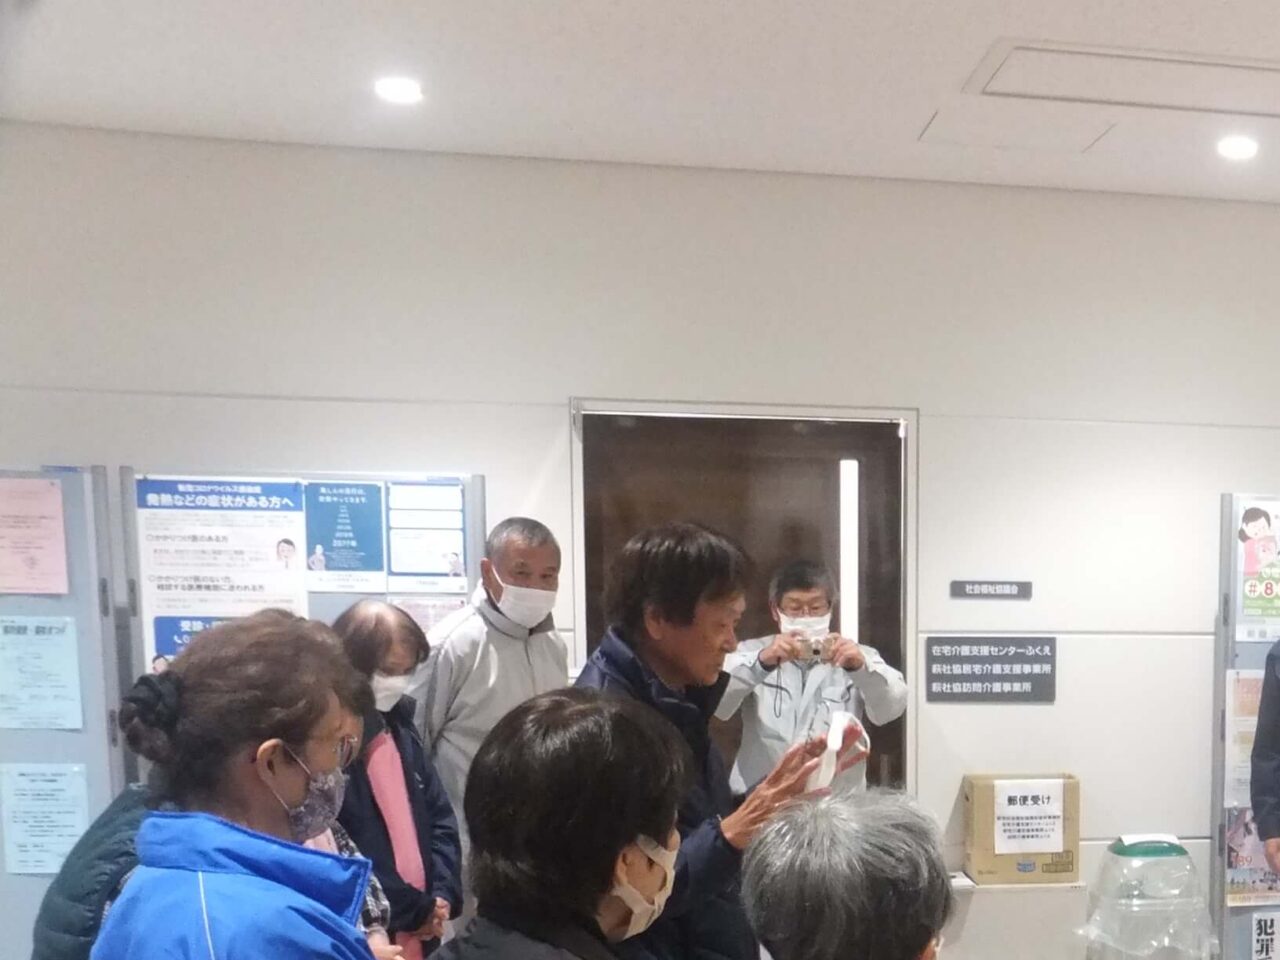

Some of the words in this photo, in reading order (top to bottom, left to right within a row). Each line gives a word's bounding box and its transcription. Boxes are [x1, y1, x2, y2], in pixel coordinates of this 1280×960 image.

[146, 493, 294, 508] 発熱などの症状がある方へ
[965, 584, 1019, 594] 社会福祉協議会
[932, 645, 1051, 656] 在宅介護支援センターふくえ
[1007, 795, 1051, 806] 郵便受け
